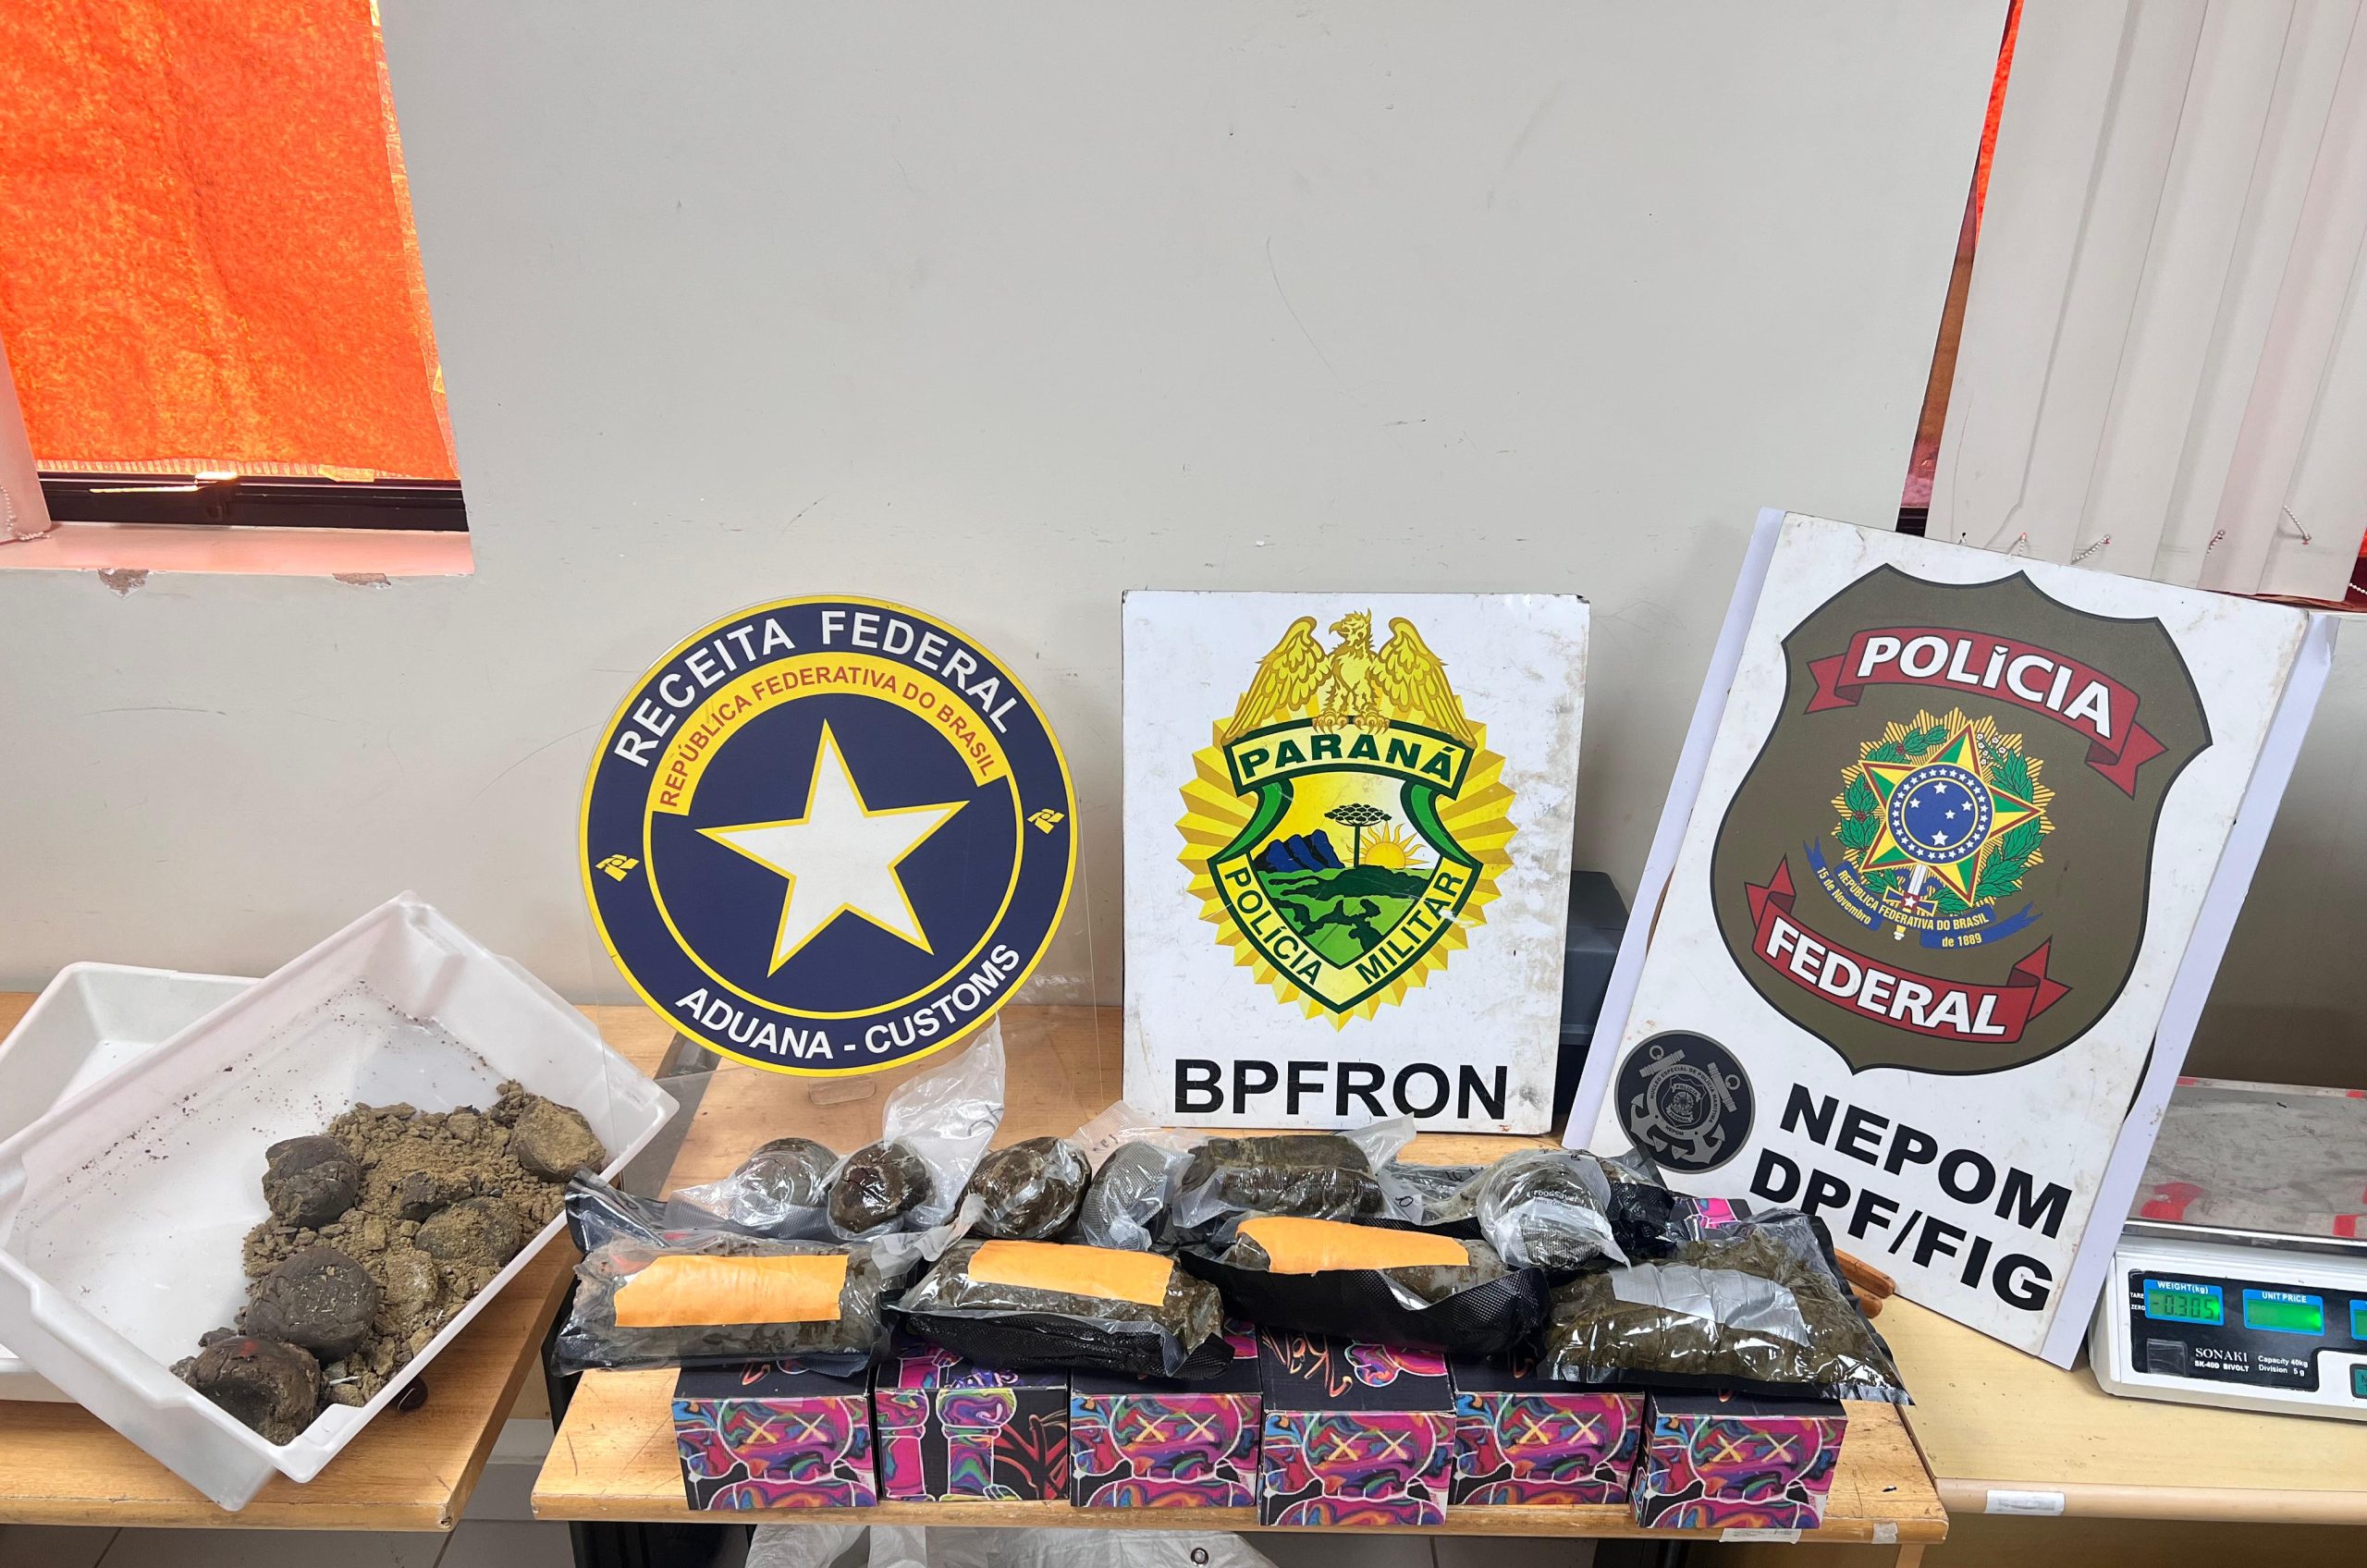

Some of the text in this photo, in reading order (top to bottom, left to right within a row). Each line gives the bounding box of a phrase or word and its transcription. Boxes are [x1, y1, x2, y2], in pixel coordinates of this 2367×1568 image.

[614, 610, 1023, 767] RECEITA FEDERAL
[1856, 634, 2114, 740] POLÍCIA
[659, 666, 996, 808] REPÚBLICA FEDERATIVA DO BRASIL
[1240, 731, 1456, 784] PARANÁ
[1223, 864, 1322, 986] POLÍCIA
[1355, 870, 1465, 986] MILITAR
[1817, 866, 1982, 948] 15 de Novembro de 1889
[1877, 904, 1934, 931] FEDERATIVA
[1936, 919, 1951, 931] DO
[1953, 913, 1990, 930] BRASIL
[675, 943, 1021, 1060] ADUANA - CUSTOMS
[1764, 916, 2008, 1035] FEDERAL
[1173, 1058, 1509, 1121] BPFRON
[1661, 1066, 1687, 1078] ESPECIAL
[1665, 1125, 1685, 1136] NEPOM
[1668, 1110, 1689, 1121] FEDERAL
[1779, 1083, 2073, 1240] NEPOM
[1749, 1147, 2054, 1312] DPF/FIG
[2129, 1292, 2144, 1300] TARE
[2157, 1280, 2209, 1294] WEIGHT(kg)
[2262, 1291, 2307, 1304] UNIT PRICE
[2195, 1347, 2248, 1363] SONAKI
[2223, 1363, 2250, 1373] BIVOLT
[2258, 1354, 2309, 1368] Capacity 40kg
[2258, 1364, 2288, 1374] Division
[2299, 1369, 2305, 1378] g
